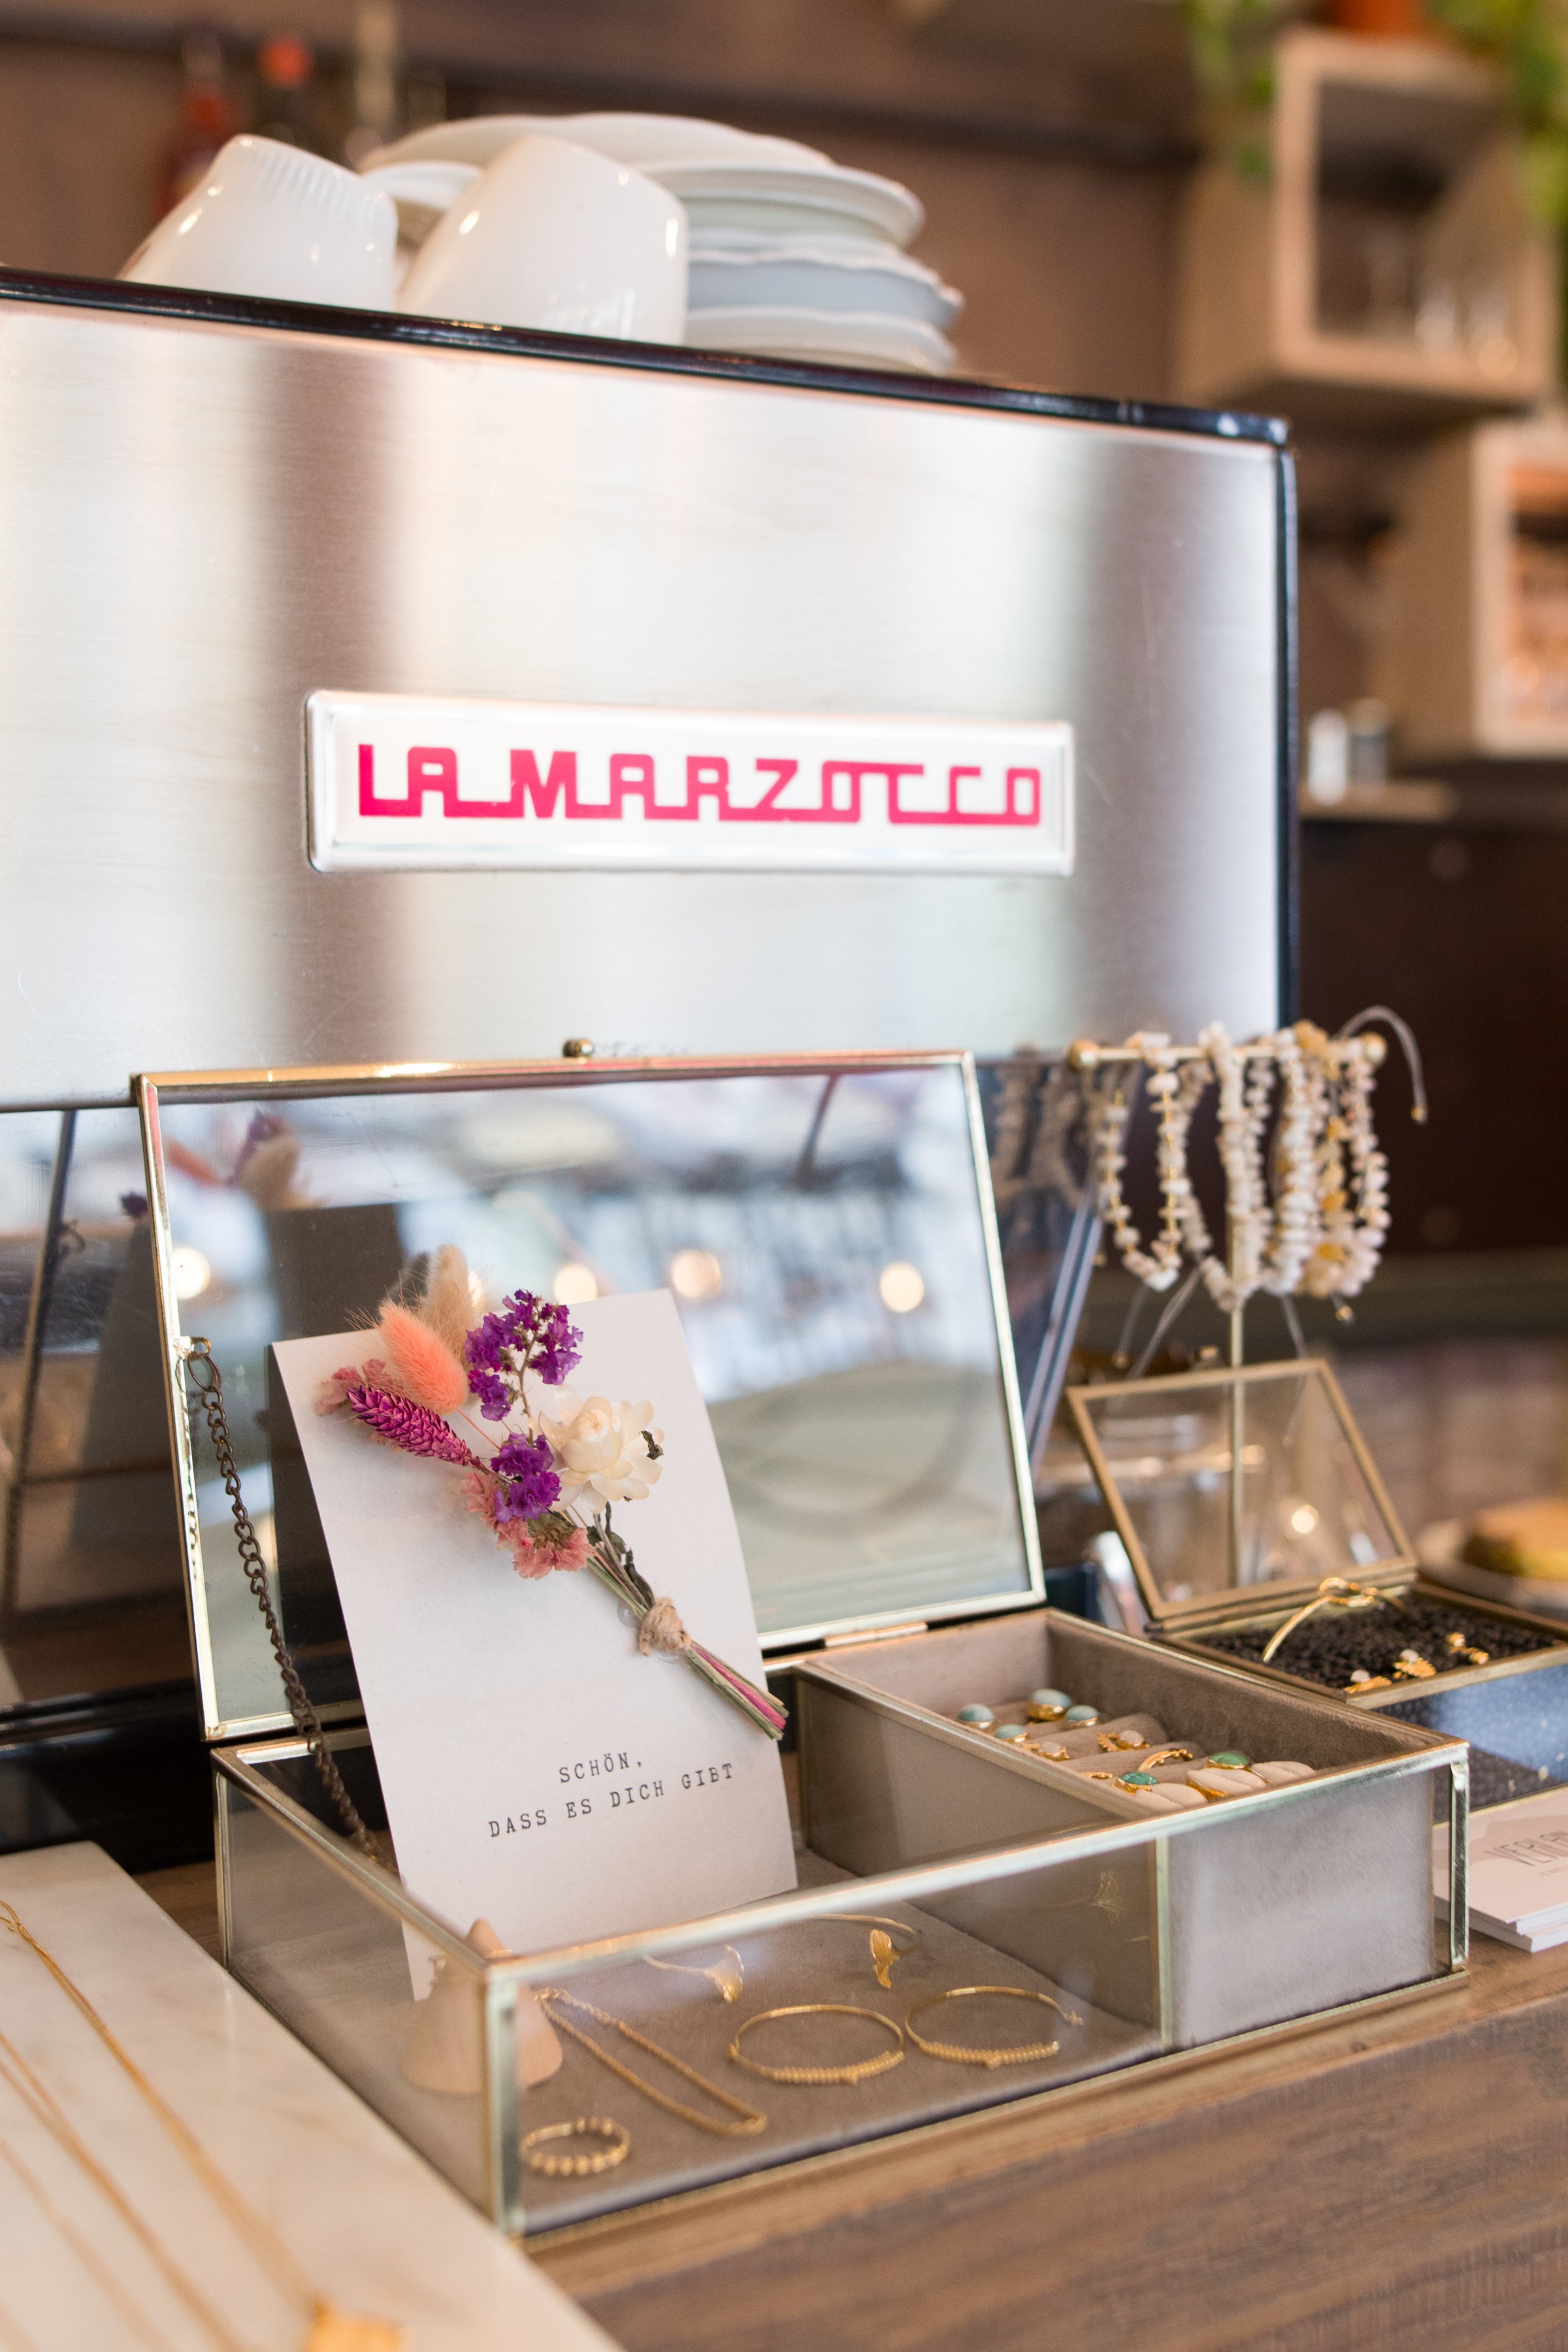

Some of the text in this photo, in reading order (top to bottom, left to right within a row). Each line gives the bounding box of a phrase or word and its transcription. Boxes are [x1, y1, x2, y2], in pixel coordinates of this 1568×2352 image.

[359, 743, 1041, 826] LA MARZOCCO
[488, 1763, 732, 1838] DASS ES DICH GIBT
[559, 1752, 642, 1784] SCHÖN,
